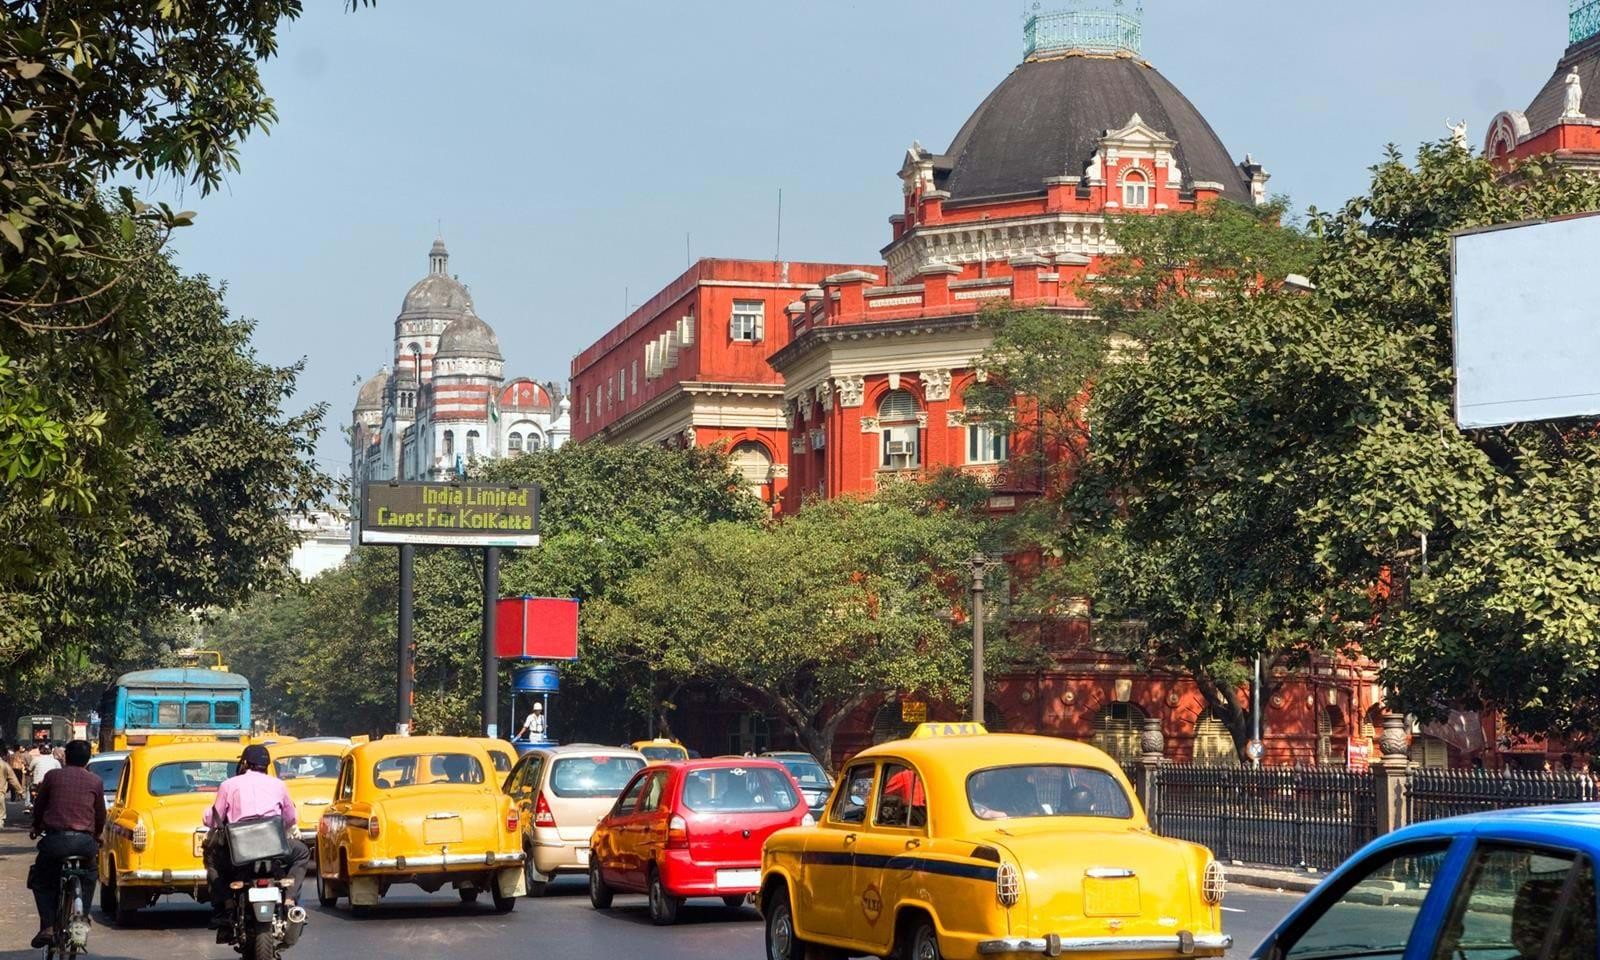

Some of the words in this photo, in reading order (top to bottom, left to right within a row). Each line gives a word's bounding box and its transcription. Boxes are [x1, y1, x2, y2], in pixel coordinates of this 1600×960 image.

[423, 486, 463, 505] India
[467, 487, 529, 507] Limited
[377, 507, 424, 527] Cares
[427, 508, 456, 528] For
[926, 724, 978, 736] TAXI
